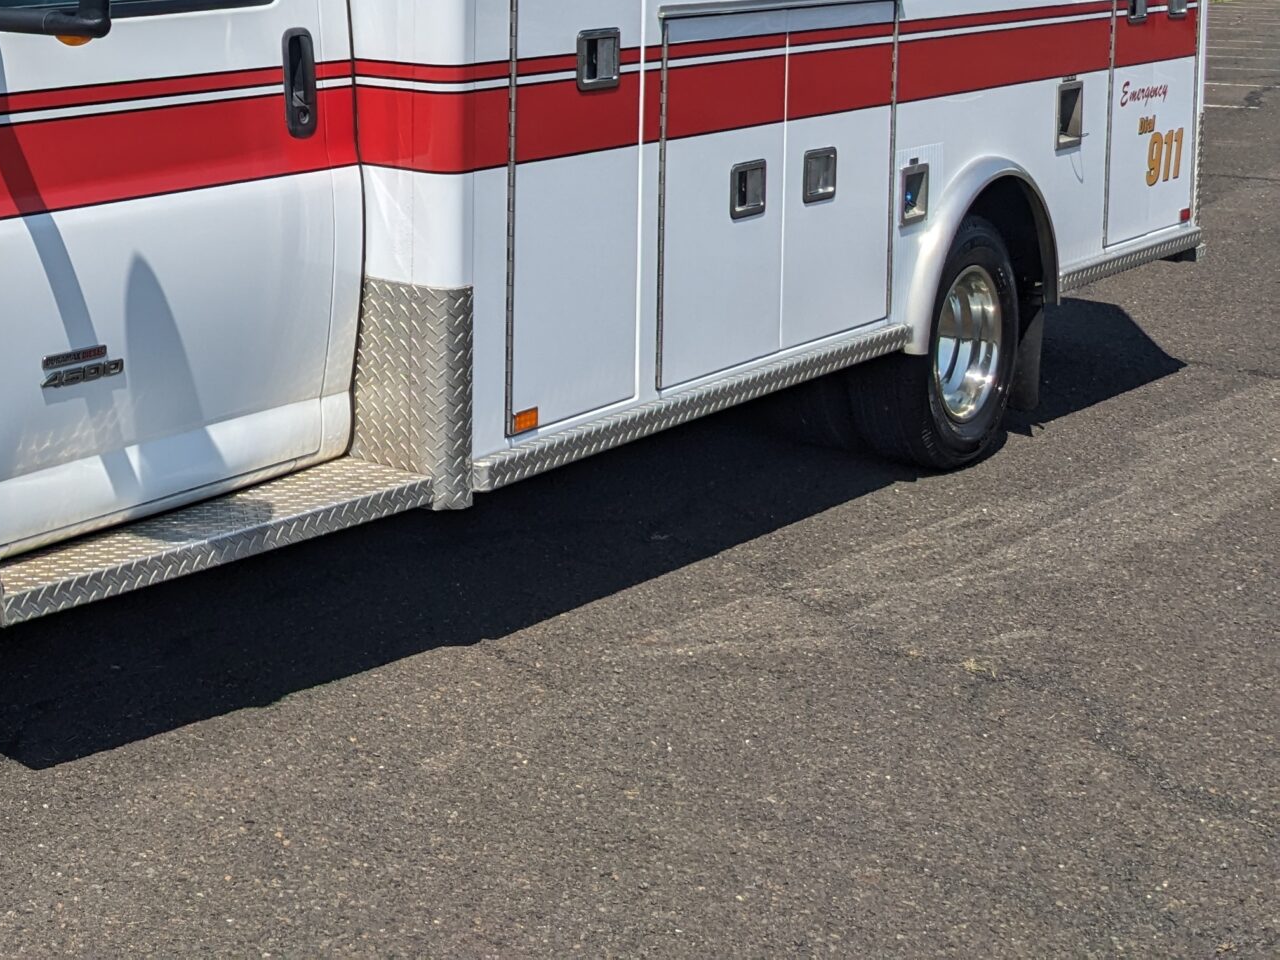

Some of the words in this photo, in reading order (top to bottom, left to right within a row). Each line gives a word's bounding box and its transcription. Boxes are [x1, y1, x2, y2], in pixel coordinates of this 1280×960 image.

[1120, 80, 1168, 107] Emergency
[1138, 114, 1156, 136] Dial
[1145, 127, 1184, 187] 911
[40, 358, 124, 389] 4500
